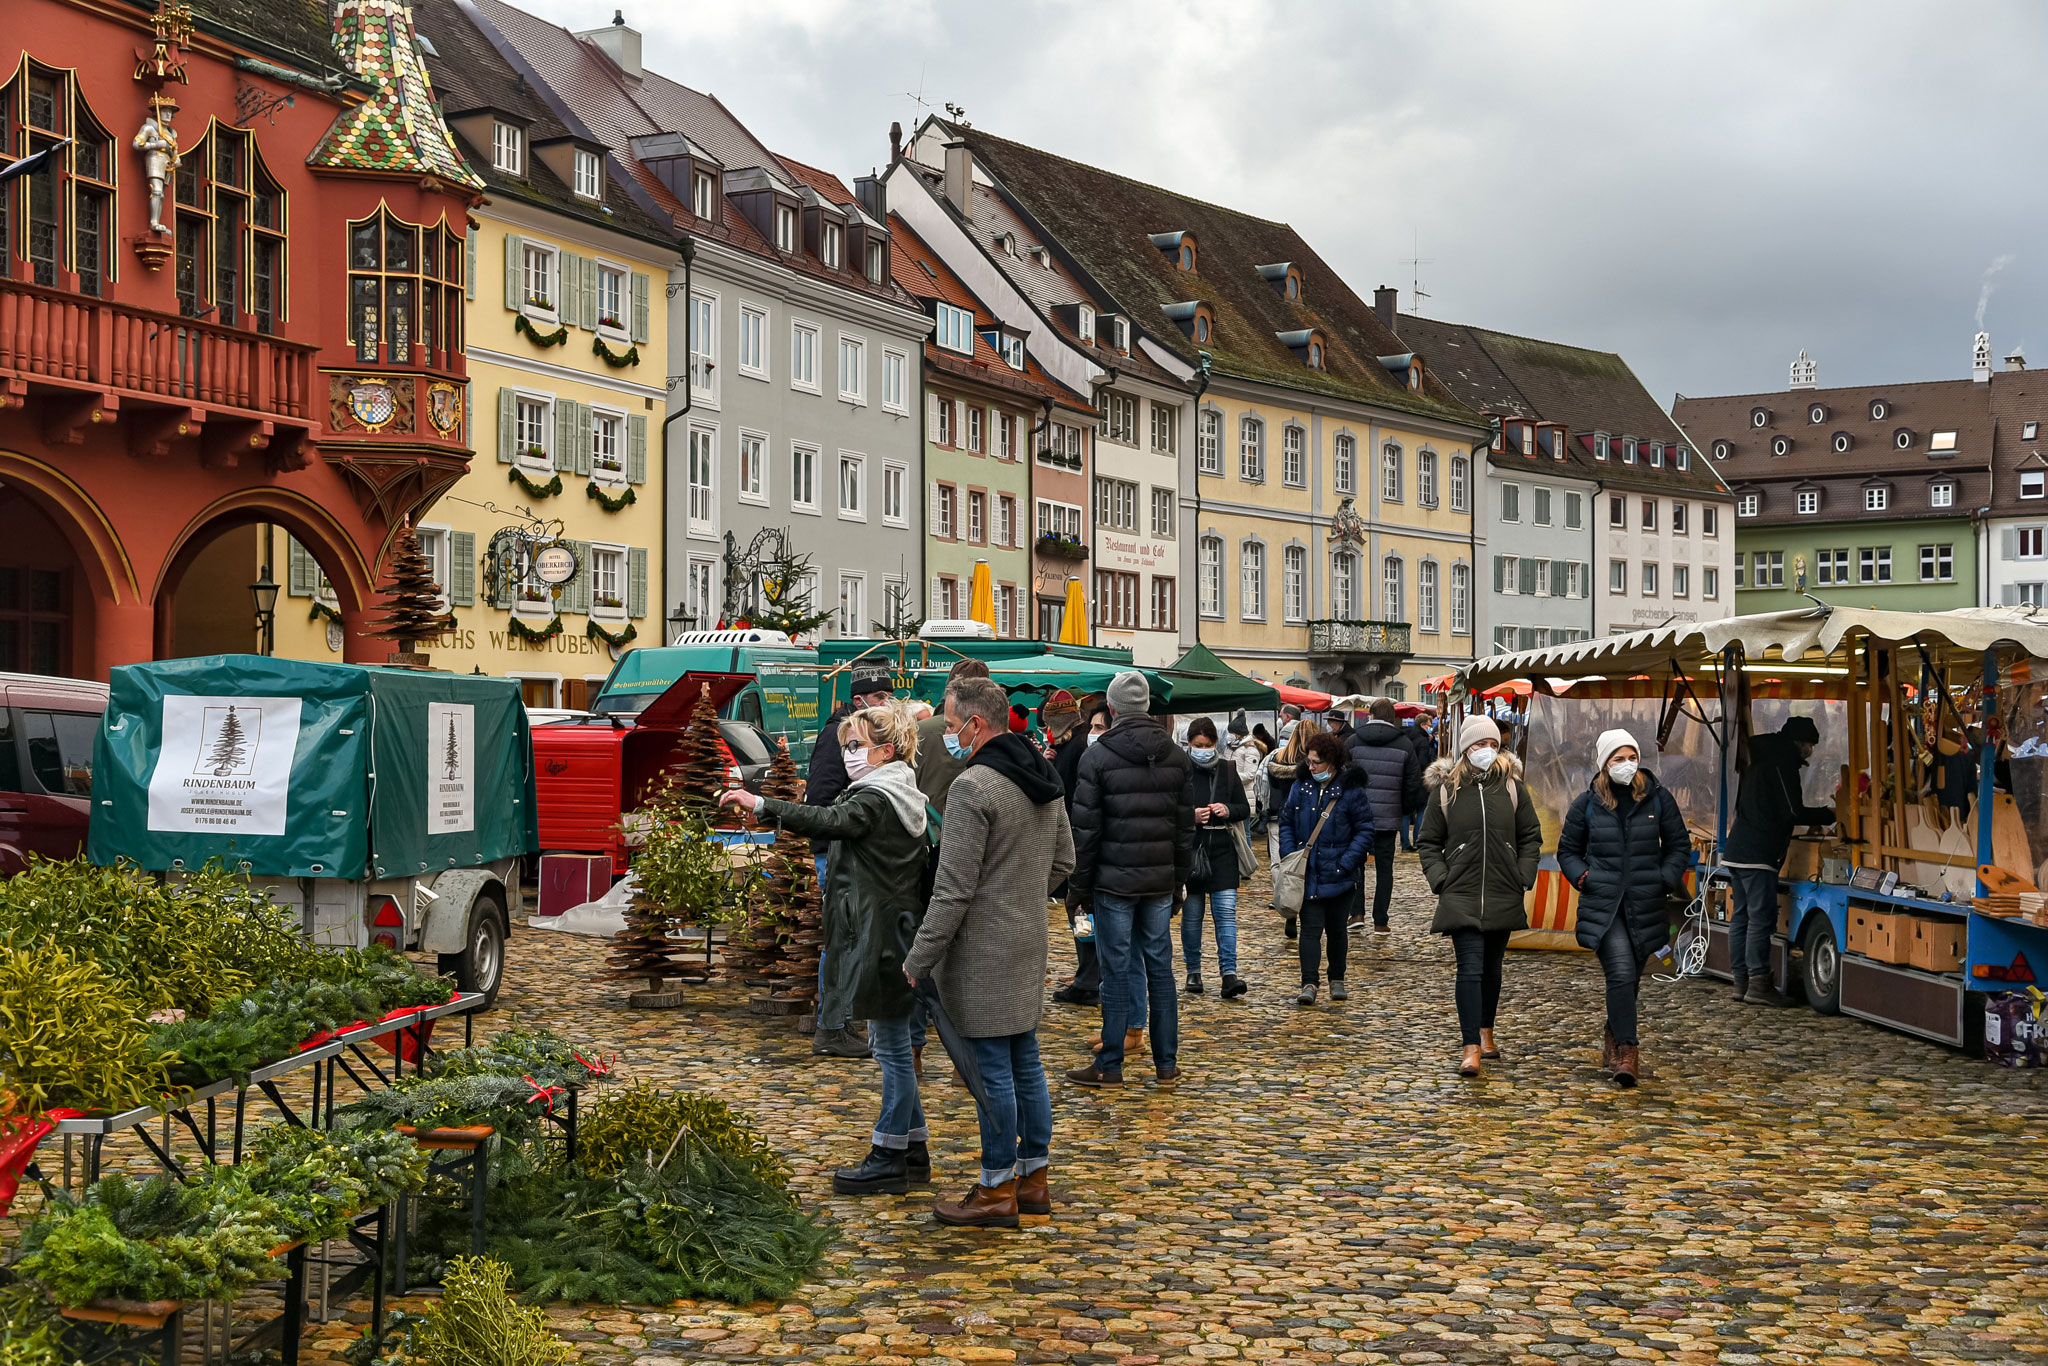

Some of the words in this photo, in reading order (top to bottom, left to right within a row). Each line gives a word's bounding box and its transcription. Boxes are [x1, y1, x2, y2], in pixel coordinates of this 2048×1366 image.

[1105, 537, 1137, 554] Restaurant
[1140, 545, 1150, 555] und
[1153, 544, 1165, 559] Café
[183, 779, 256, 789] RINDENBAUM
